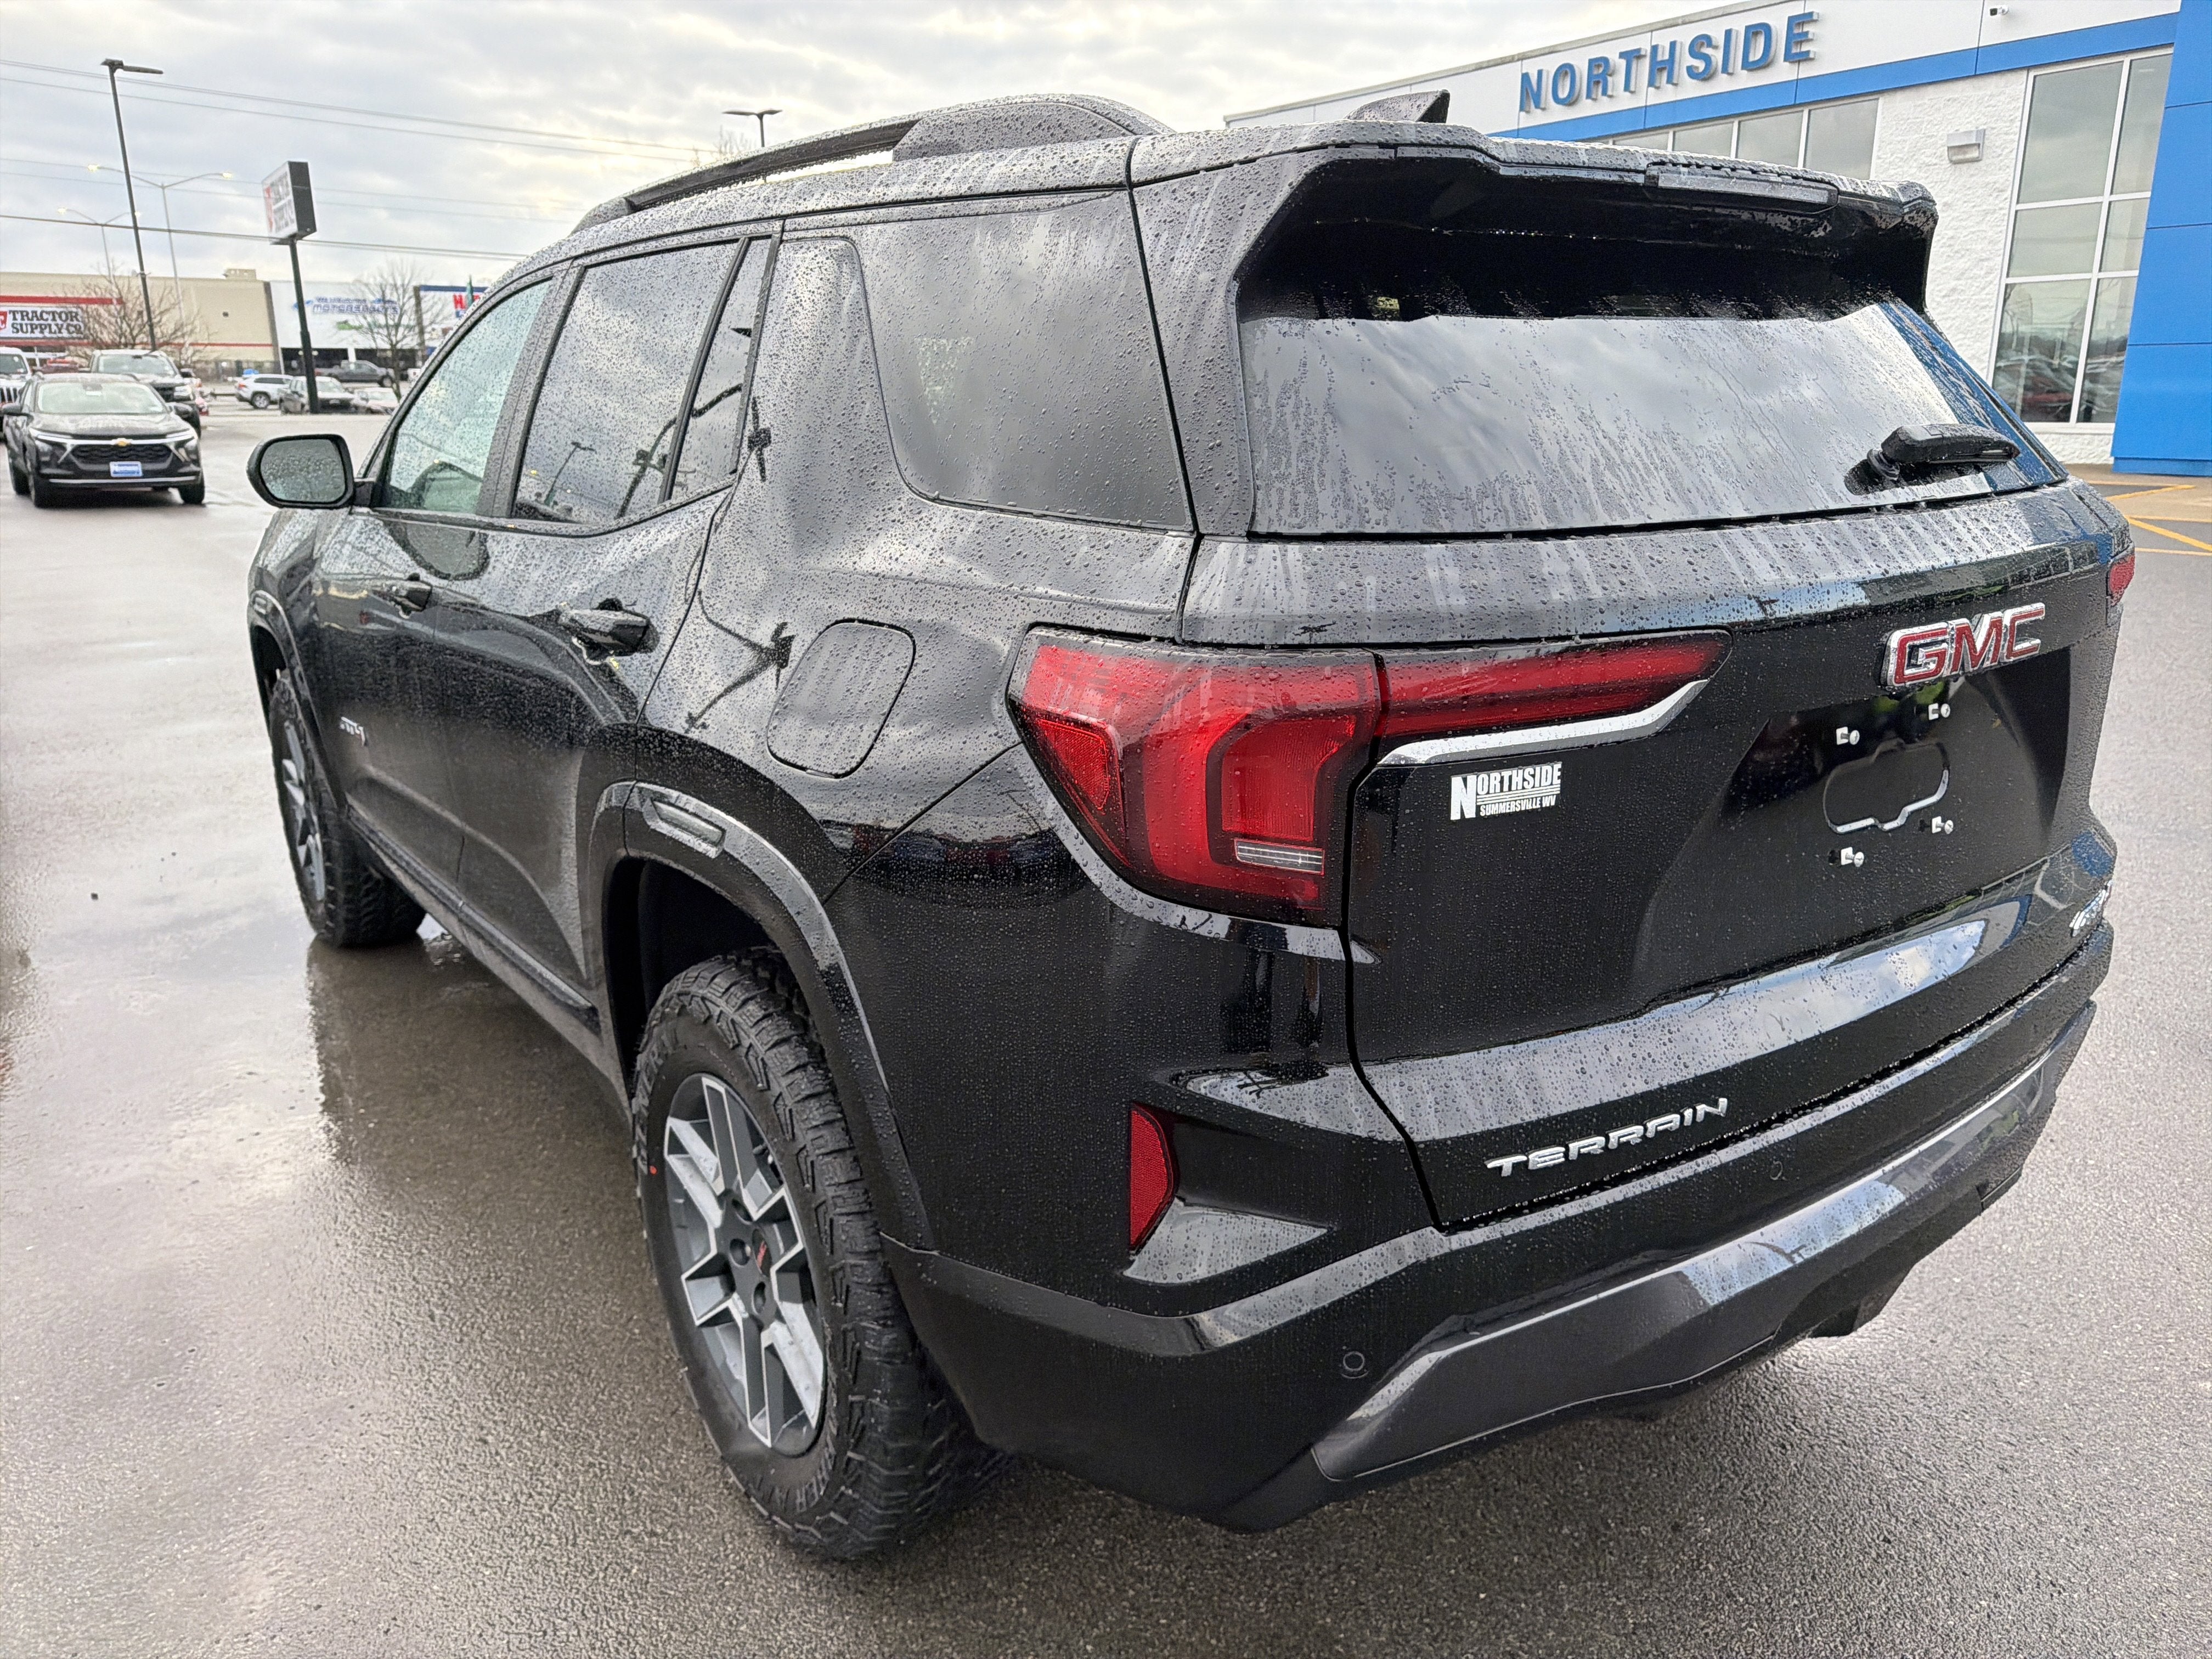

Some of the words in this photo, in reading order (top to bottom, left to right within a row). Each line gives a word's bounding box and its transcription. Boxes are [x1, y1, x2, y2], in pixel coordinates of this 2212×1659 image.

[1519, 11, 1819, 112] NORTHSIDE
[9, 310, 81, 322] TRACTOR
[11, 322, 64, 334] SUPPLY
[1881, 602, 2046, 686] GMC
[1451, 761, 1562, 820] NORTHSIDE
[1480, 797, 1541, 816] SUMMERSVILLE
[1542, 794, 1556, 808] WV
[1483, 1098, 1728, 1177] TERRAIN
